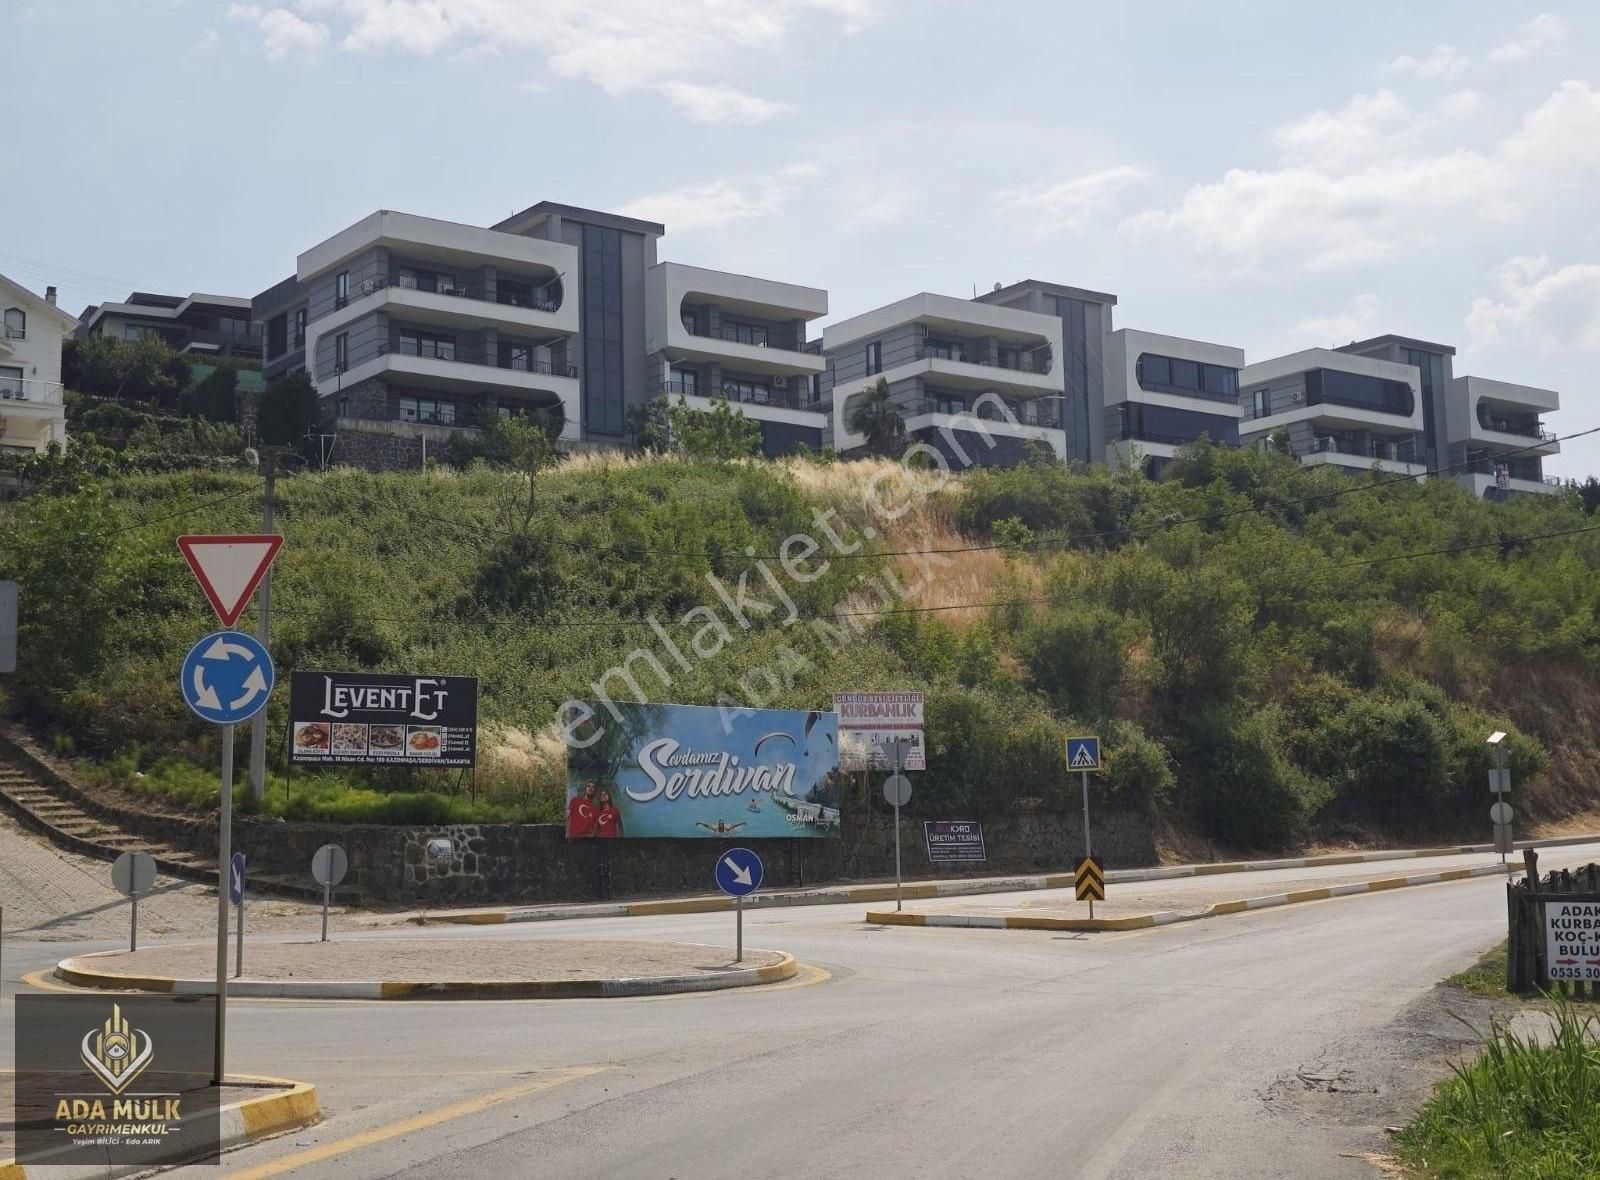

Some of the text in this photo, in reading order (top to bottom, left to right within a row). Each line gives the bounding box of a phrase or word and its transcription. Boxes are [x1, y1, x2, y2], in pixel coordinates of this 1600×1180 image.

[841, 703, 917, 718] KURBANLIK
[626, 738, 796, 802] Serdivan
[786, 814, 814, 822] OSMAN
[1551, 967, 1581, 978] 0535
